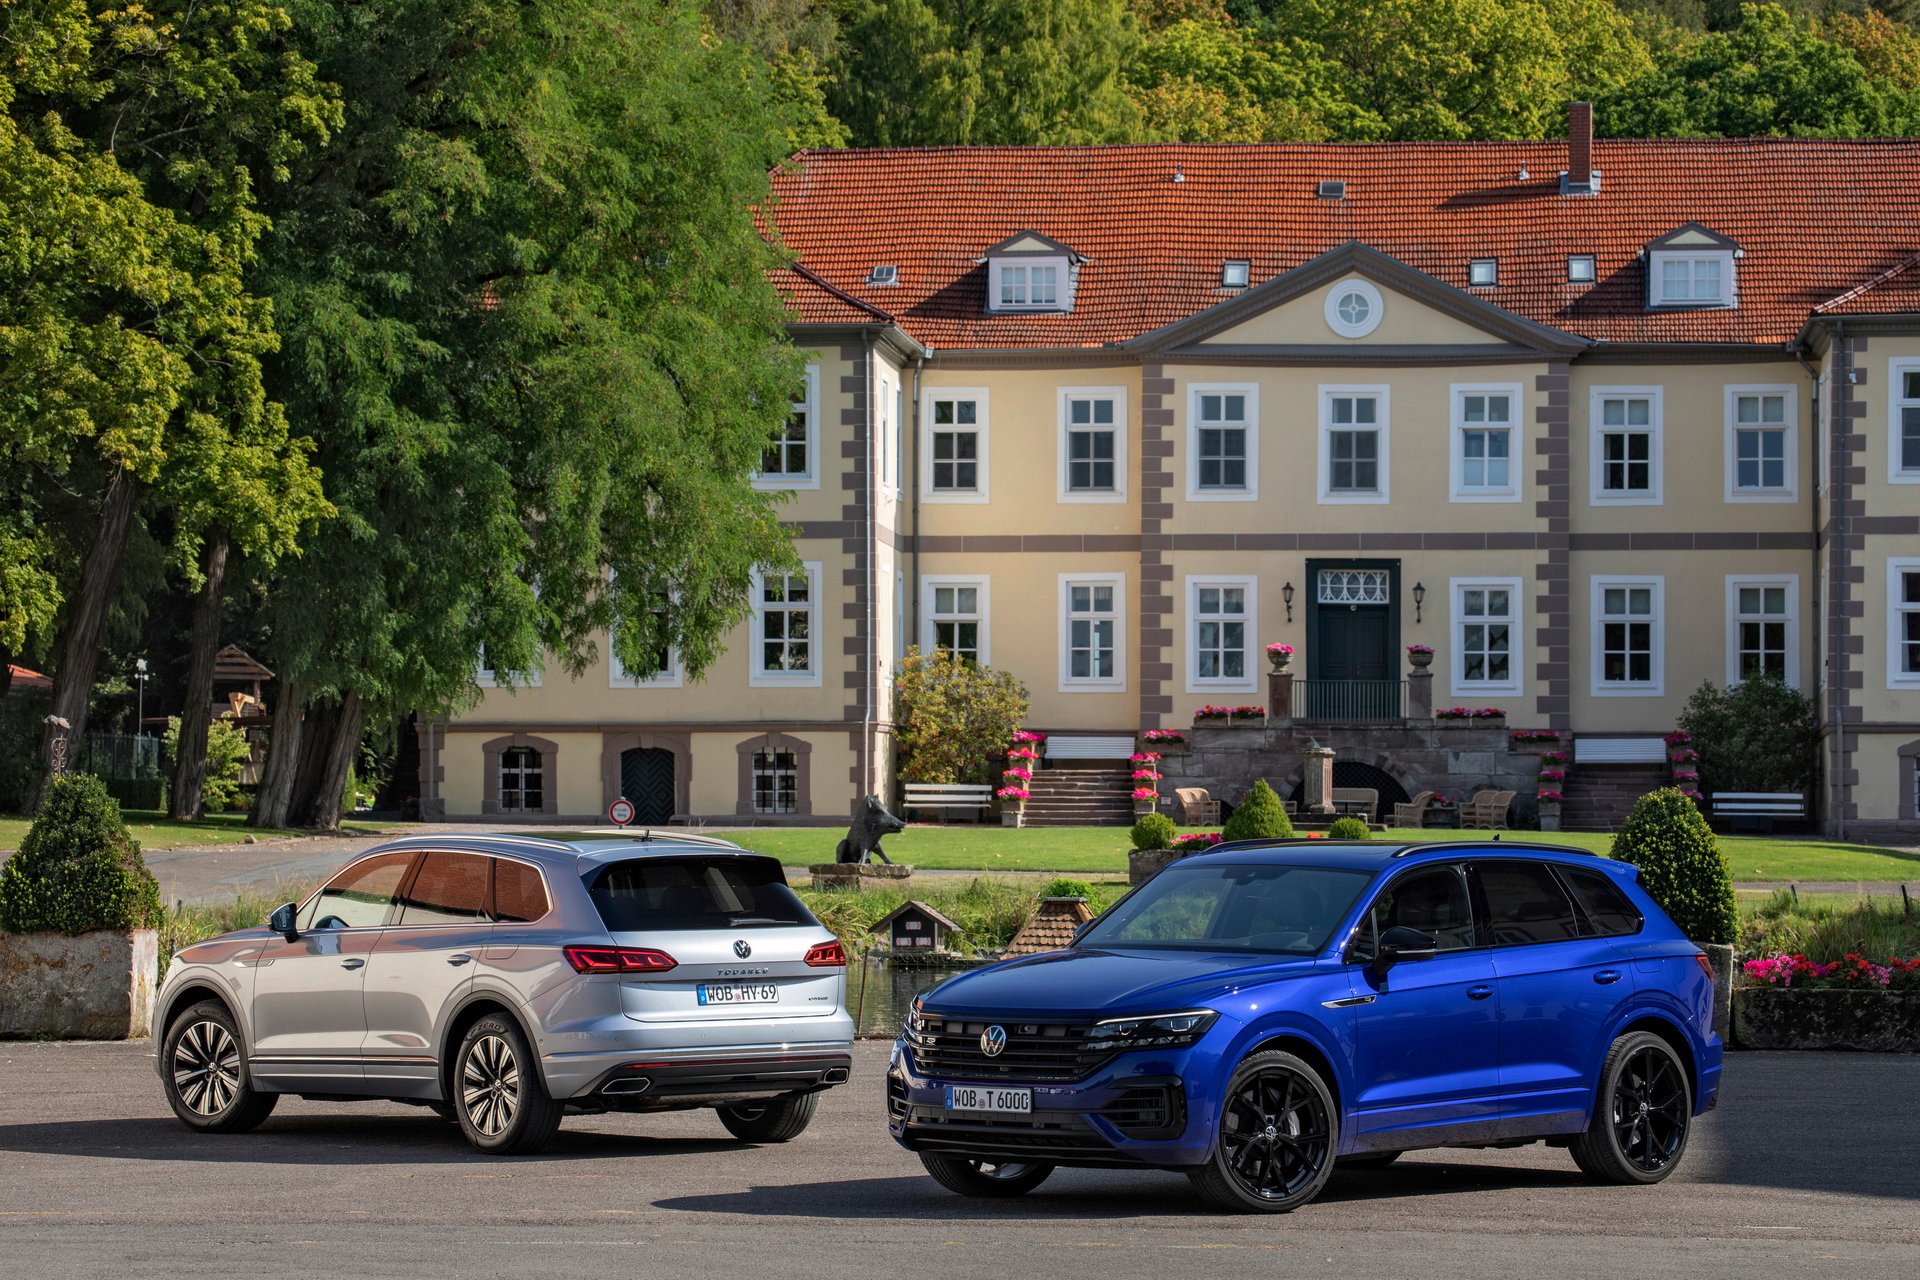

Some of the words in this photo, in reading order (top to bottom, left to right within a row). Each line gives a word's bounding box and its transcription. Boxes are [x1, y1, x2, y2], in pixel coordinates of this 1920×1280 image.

[707, 986, 733, 1001] WOB
[954, 1089, 977, 1107] WOB
[986, 1091, 994, 1108] T
[997, 1091, 1029, 1110] 6000
